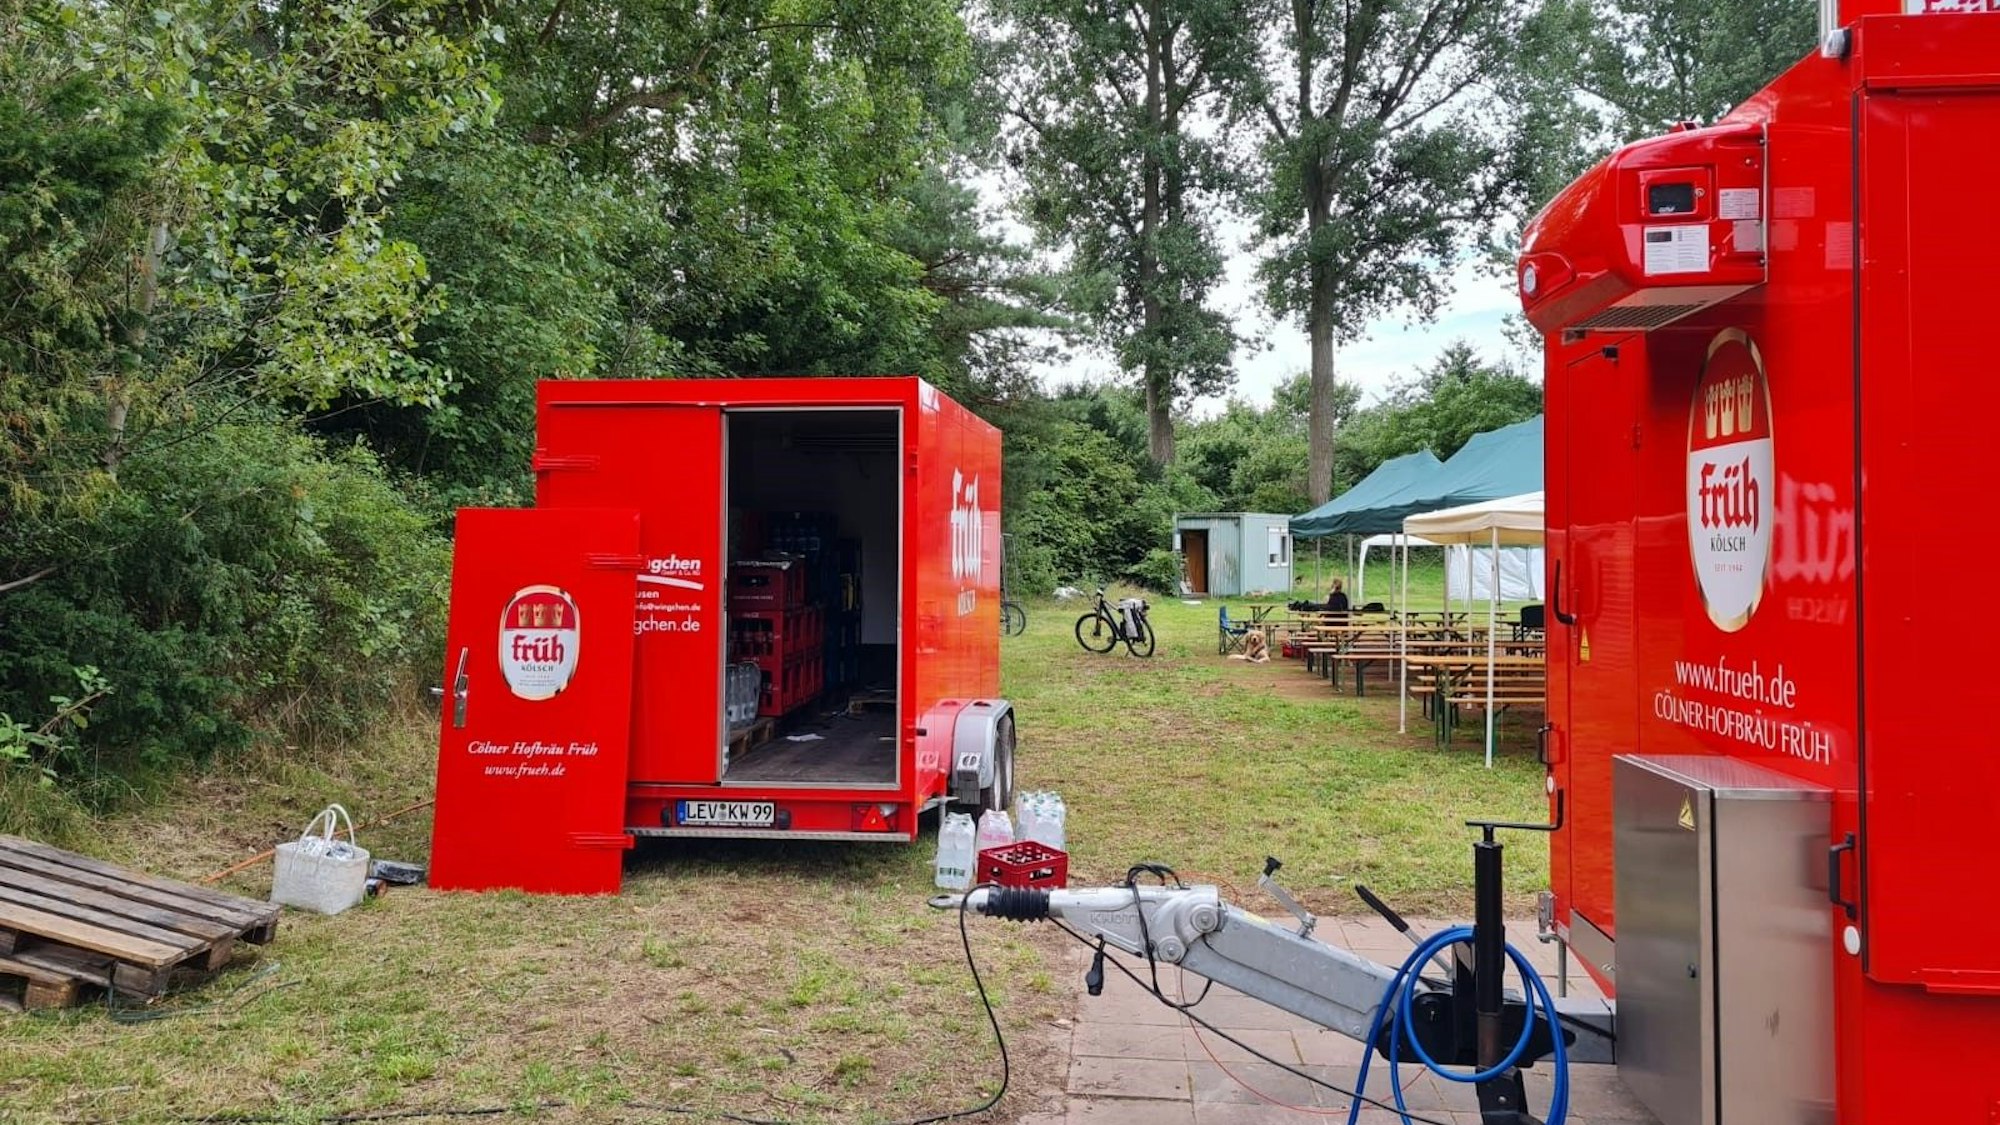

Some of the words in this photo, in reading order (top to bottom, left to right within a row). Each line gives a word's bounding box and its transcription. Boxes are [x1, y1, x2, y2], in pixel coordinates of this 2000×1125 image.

[1699, 456, 1760, 535] früh
[1710, 534, 1746, 552] KÖLSCH
[512, 634, 564, 665] früh
[1675, 655, 1797, 709] www.frueh.de
[1655, 689, 1703, 731] CÖLNER
[1705, 705, 1776, 750] HOFBRÄU
[1781, 721, 1830, 765] FRÜH
[467, 740, 510, 755] Cölner
[511, 741, 565, 759] Hofbräu
[567, 742, 599, 756] Früh
[484, 762, 567, 779] www.frueh.de
[687, 803, 718, 819] LEV
[728, 804, 749, 820] KW
[752, 804, 772, 820] 99
